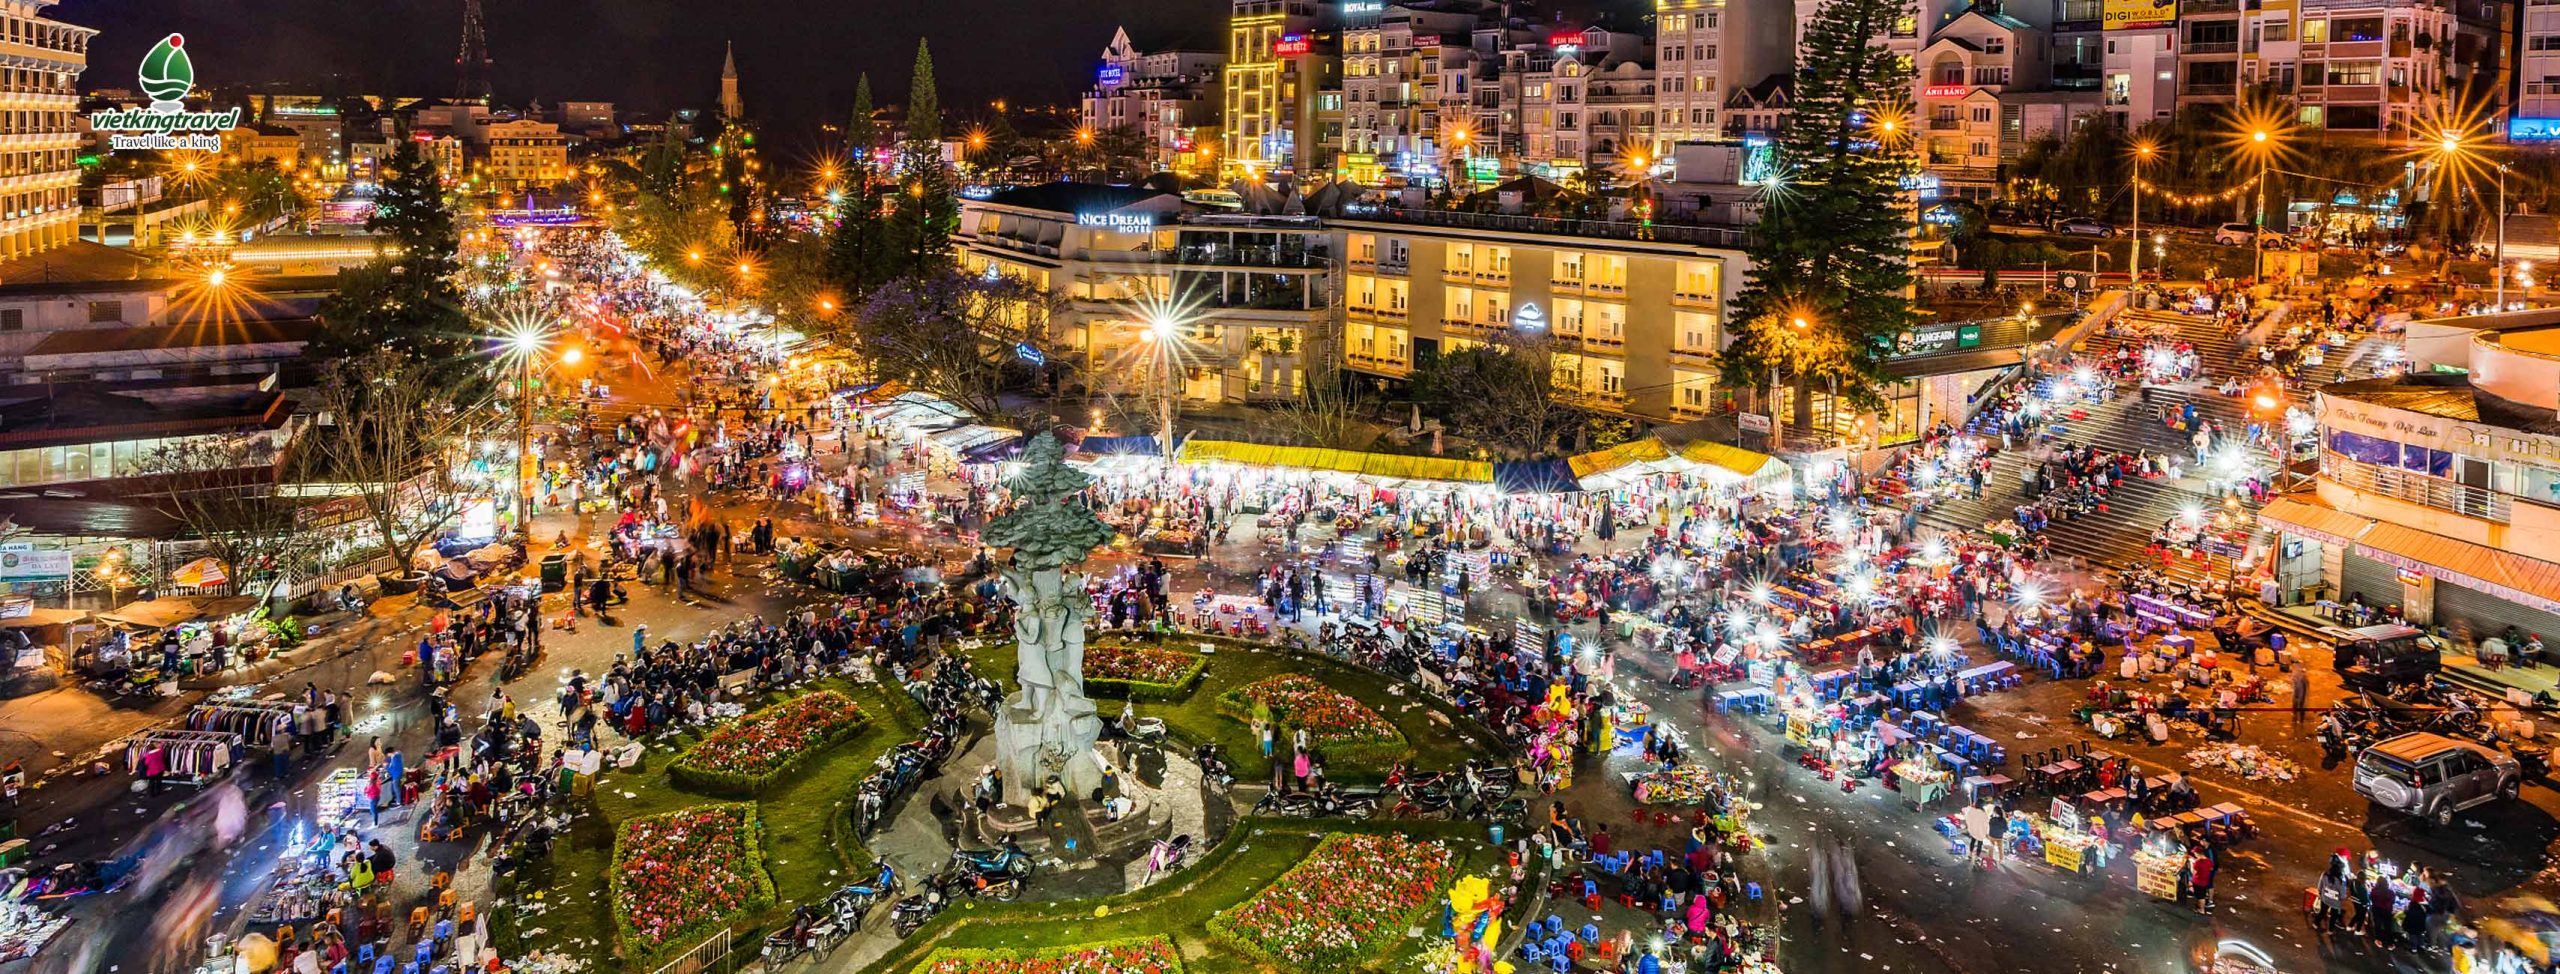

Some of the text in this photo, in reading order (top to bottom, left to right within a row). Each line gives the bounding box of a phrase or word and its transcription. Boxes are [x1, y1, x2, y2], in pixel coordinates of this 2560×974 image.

[1344, 2, 1366, 12] ROYAL
[2105, 11, 2131, 20] DIGI
[1943, 87, 1966, 95] SÁNG
[1109, 214, 1151, 226] DREAM
[1119, 225, 1152, 233] HOTEL
